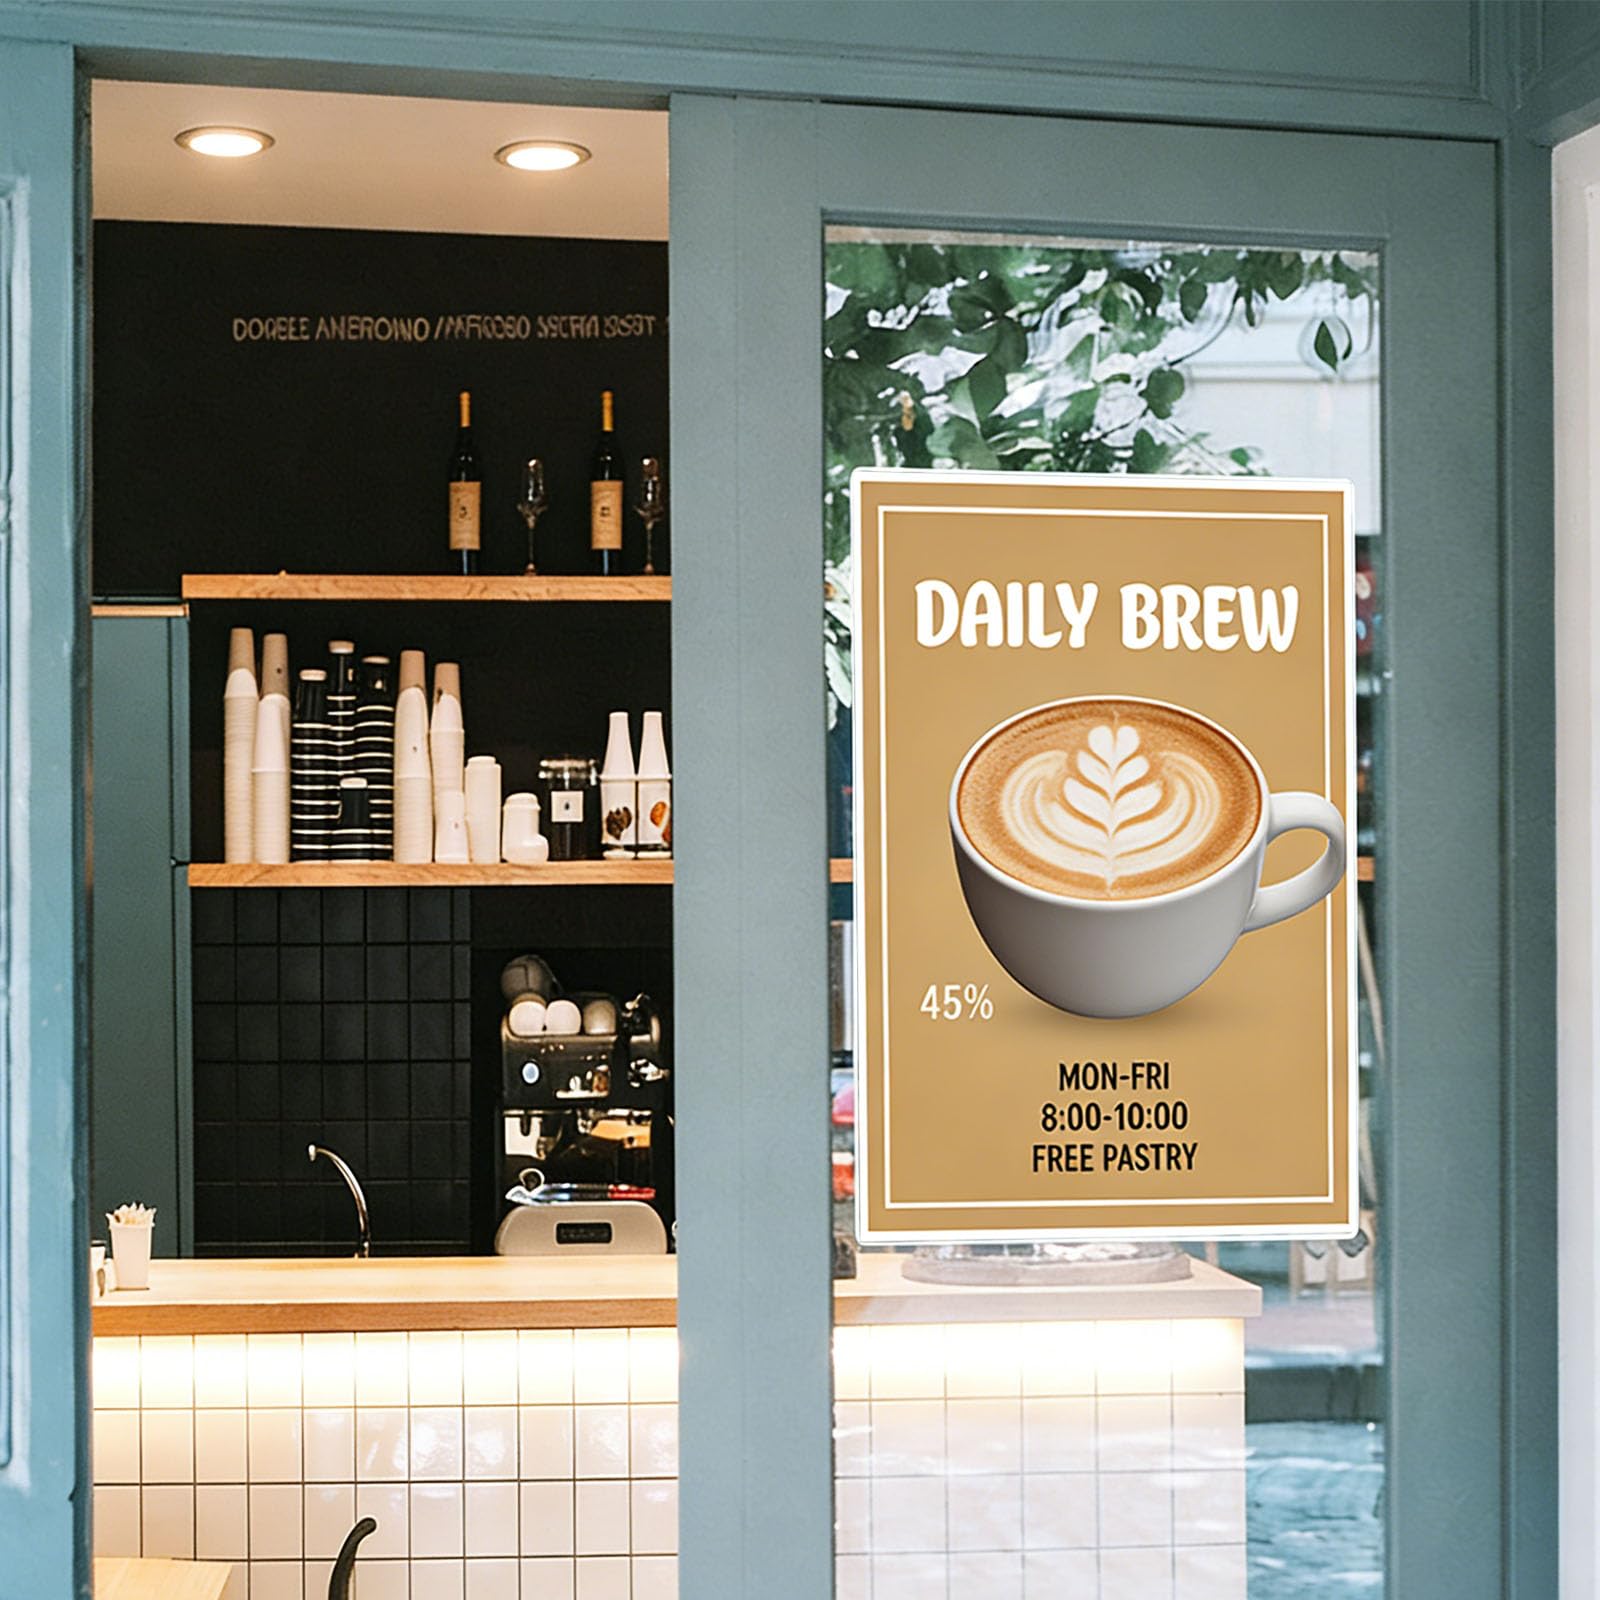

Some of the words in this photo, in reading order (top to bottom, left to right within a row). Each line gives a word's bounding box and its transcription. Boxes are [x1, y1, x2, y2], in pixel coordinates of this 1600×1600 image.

[915, 579, 1098, 649] DAILY
[1120, 582, 1299, 653] BREW
[920, 983, 994, 1020] 45%
[1058, 1061, 1170, 1091] MON-FRI
[1040, 1100, 1189, 1132] 8:00-10:00
[1032, 1143, 1094, 1173] FREE
[1103, 1142, 1198, 1172] PASTRY
